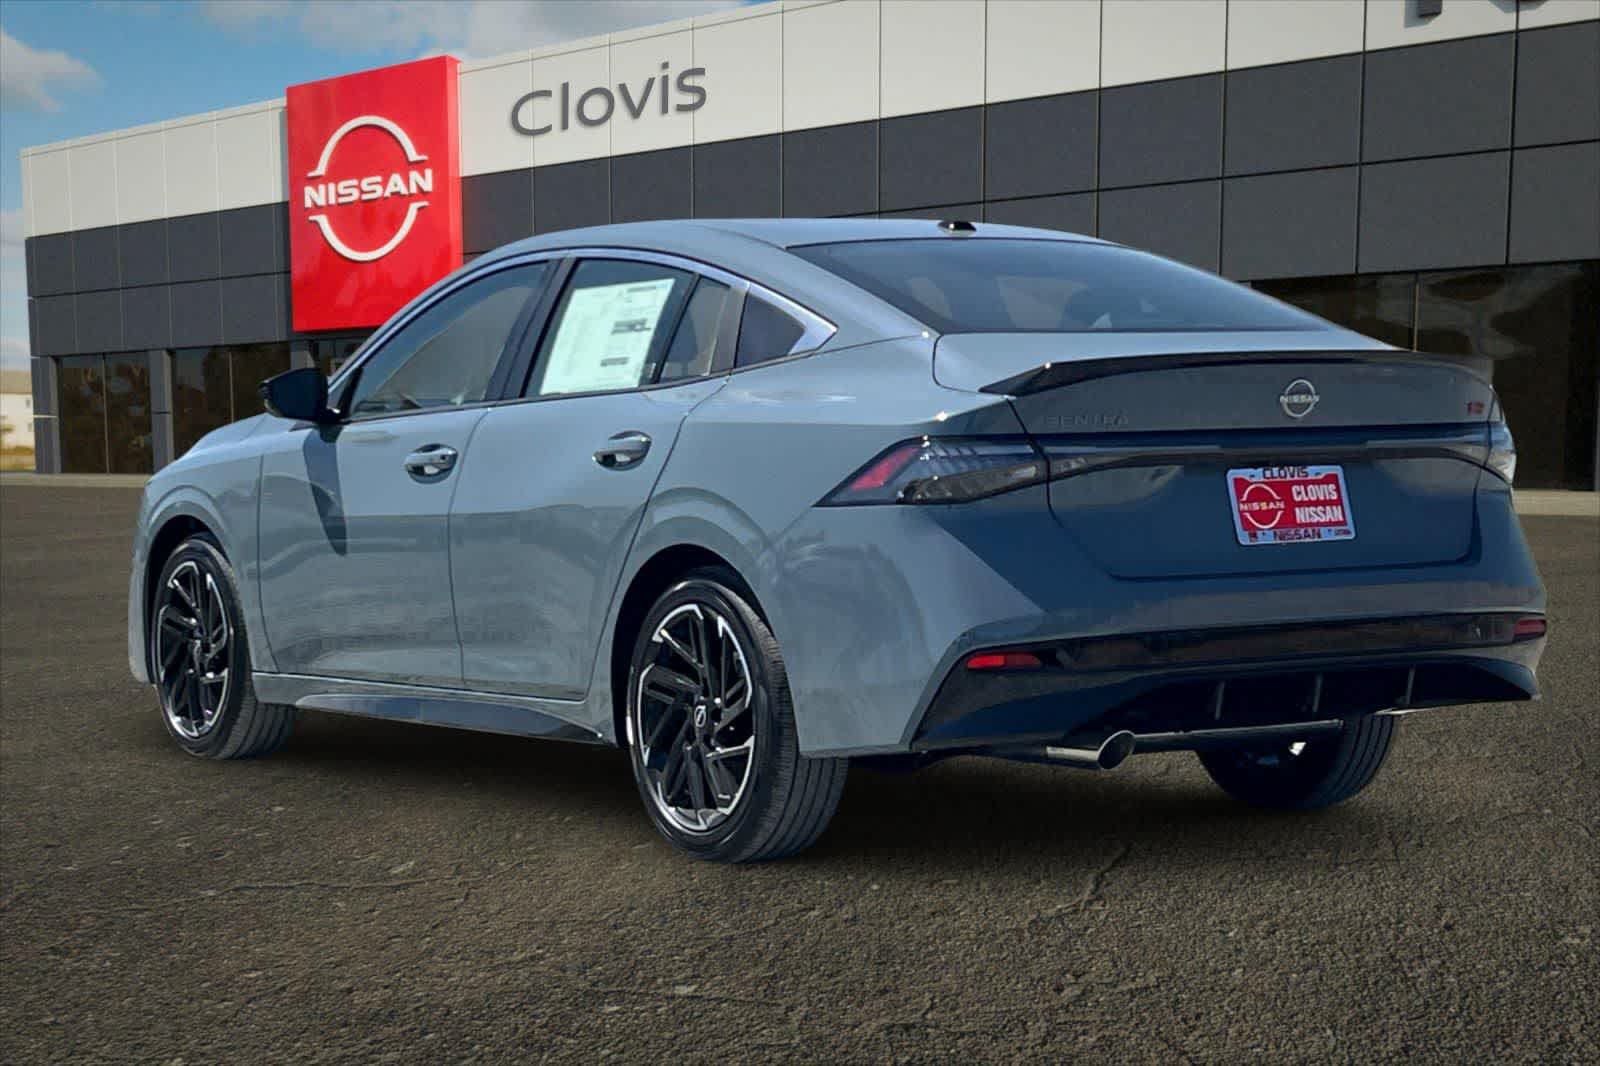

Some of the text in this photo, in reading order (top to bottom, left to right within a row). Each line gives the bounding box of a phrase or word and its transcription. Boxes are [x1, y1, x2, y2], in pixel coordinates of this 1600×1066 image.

[510, 61, 707, 136] Clovis
[303, 168, 433, 208] NISSAN
[1263, 466, 1309, 481] CLOVIS
[1291, 483, 1338, 502] CLOVIS
[1239, 501, 1285, 511] NISSAN
[1295, 505, 1344, 524] NISSAN
[1273, 528, 1322, 541] NISSAN
